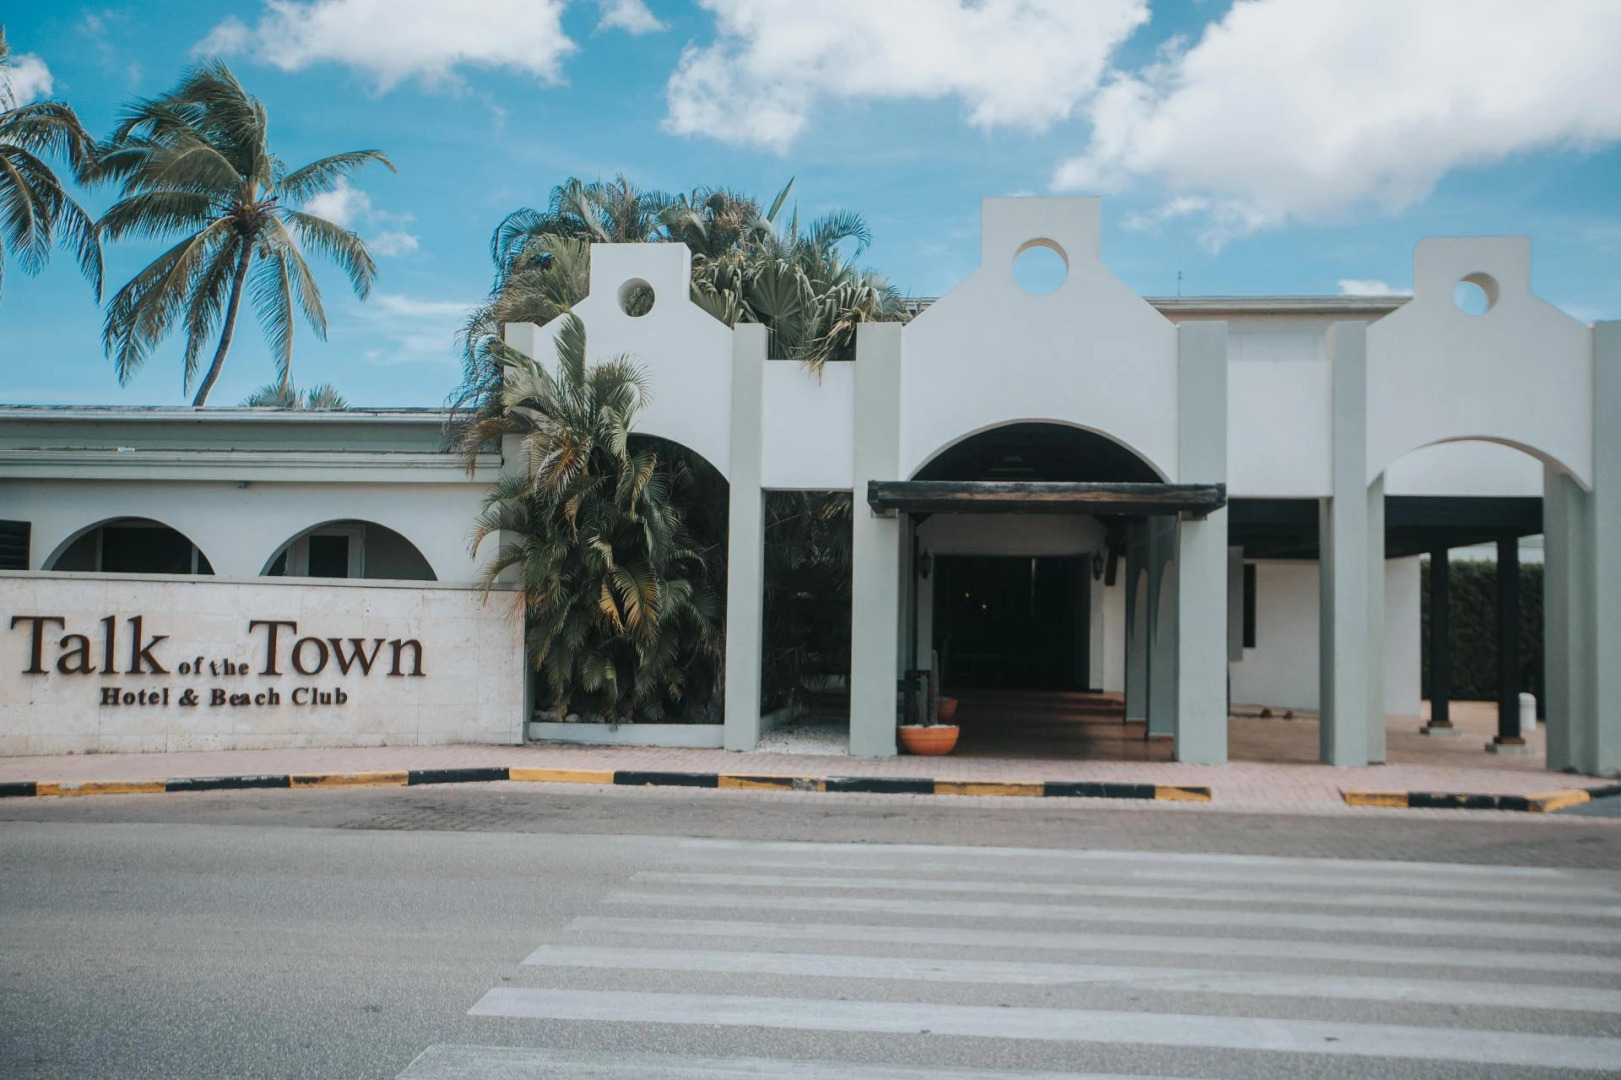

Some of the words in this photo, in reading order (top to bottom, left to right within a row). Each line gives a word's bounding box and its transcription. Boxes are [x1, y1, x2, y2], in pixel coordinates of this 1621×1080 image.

[11, 615, 171, 675] Talk
[178, 656, 205, 675] of
[210, 658, 250, 676] the
[248, 620, 427, 677] Town
[100, 687, 170, 706] Hotel
[179, 688, 199, 706] &
[210, 688, 281, 707] Beach
[292, 687, 349, 706] Club
